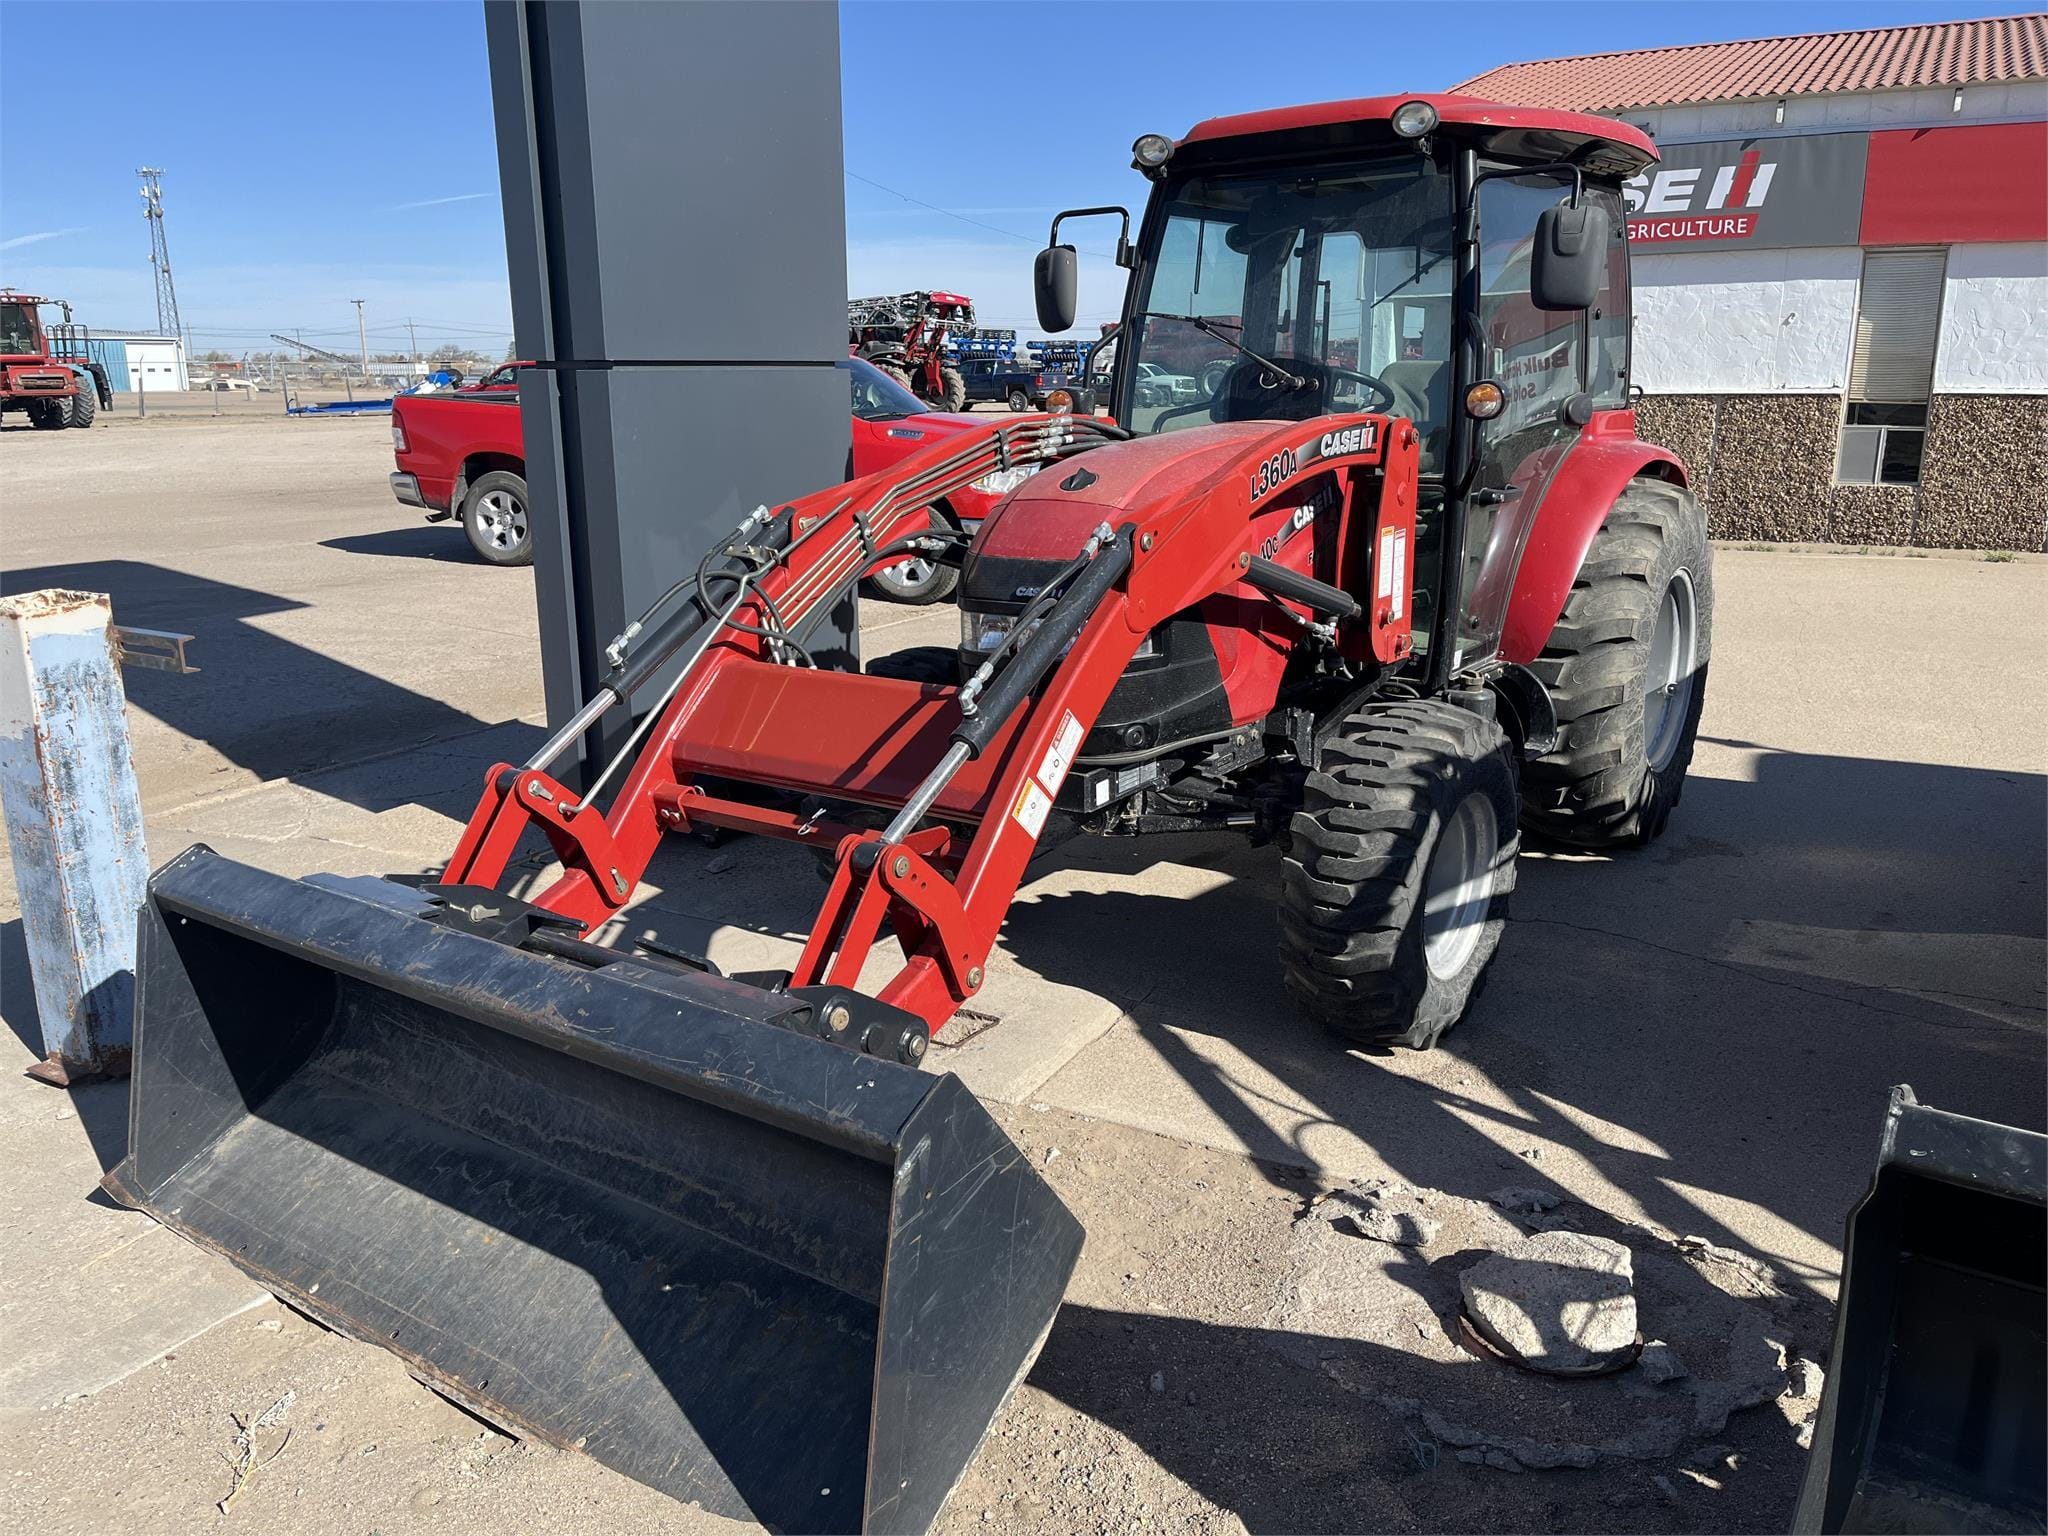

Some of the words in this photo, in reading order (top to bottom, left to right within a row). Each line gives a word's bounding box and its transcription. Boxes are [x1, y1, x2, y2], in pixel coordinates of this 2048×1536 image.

[1627, 218, 1748, 240] GRICULTURE
[1320, 429, 1361, 457] CASE
[1250, 448, 1299, 503] L360A
[1015, 586, 1041, 597] CAS
